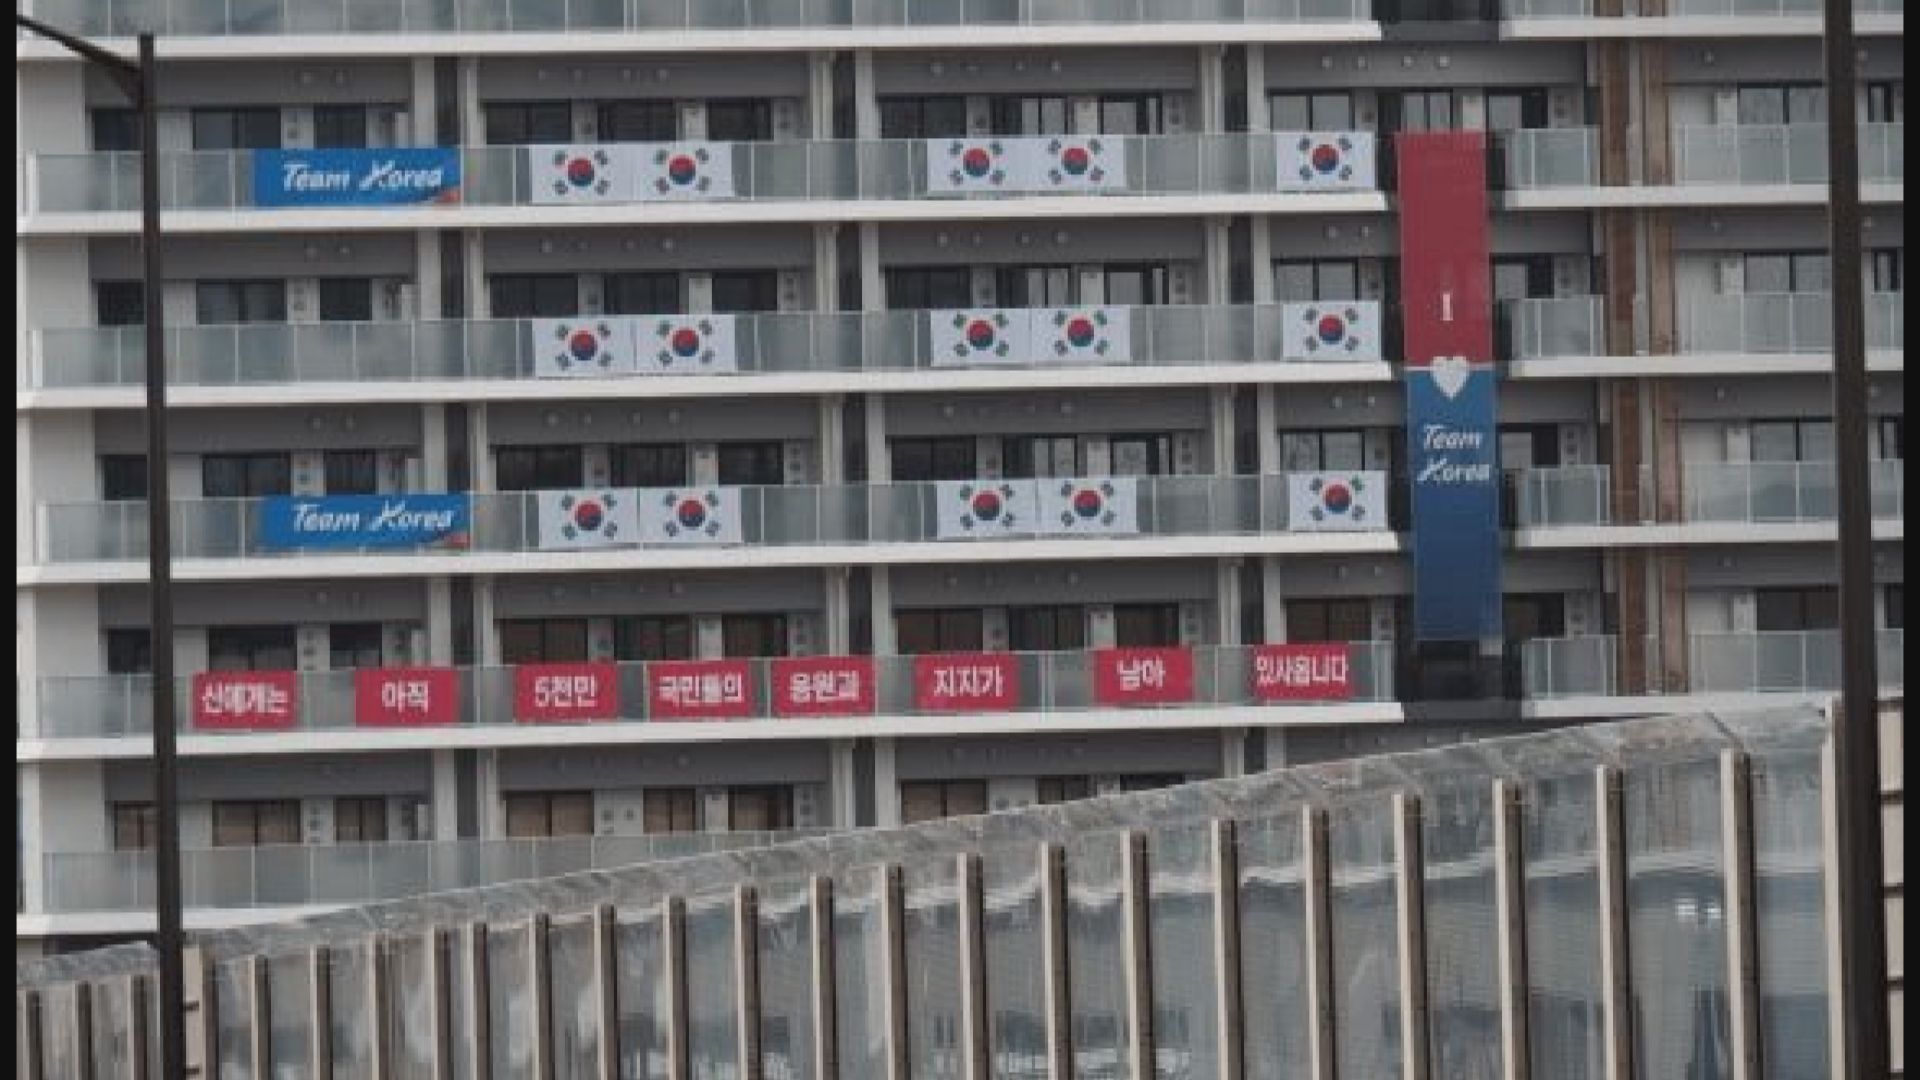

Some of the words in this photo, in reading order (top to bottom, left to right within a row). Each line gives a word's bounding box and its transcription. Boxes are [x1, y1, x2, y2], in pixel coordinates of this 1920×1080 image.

[283, 163, 350, 191] Team
[359, 160, 443, 191] Korea
[1423, 424, 1482, 449] Team
[1417, 457, 1490, 482] Korea
[293, 503, 360, 531] Team
[369, 500, 454, 531] Korea
[381, 681, 429, 713] 아직
[535, 673, 597, 707] 5천만
[789, 670, 860, 703] 응원과
[932, 665, 1004, 698] 지지가
[1116, 659, 1166, 691] 남아
[1256, 654, 1350, 687] 있사옵니다
